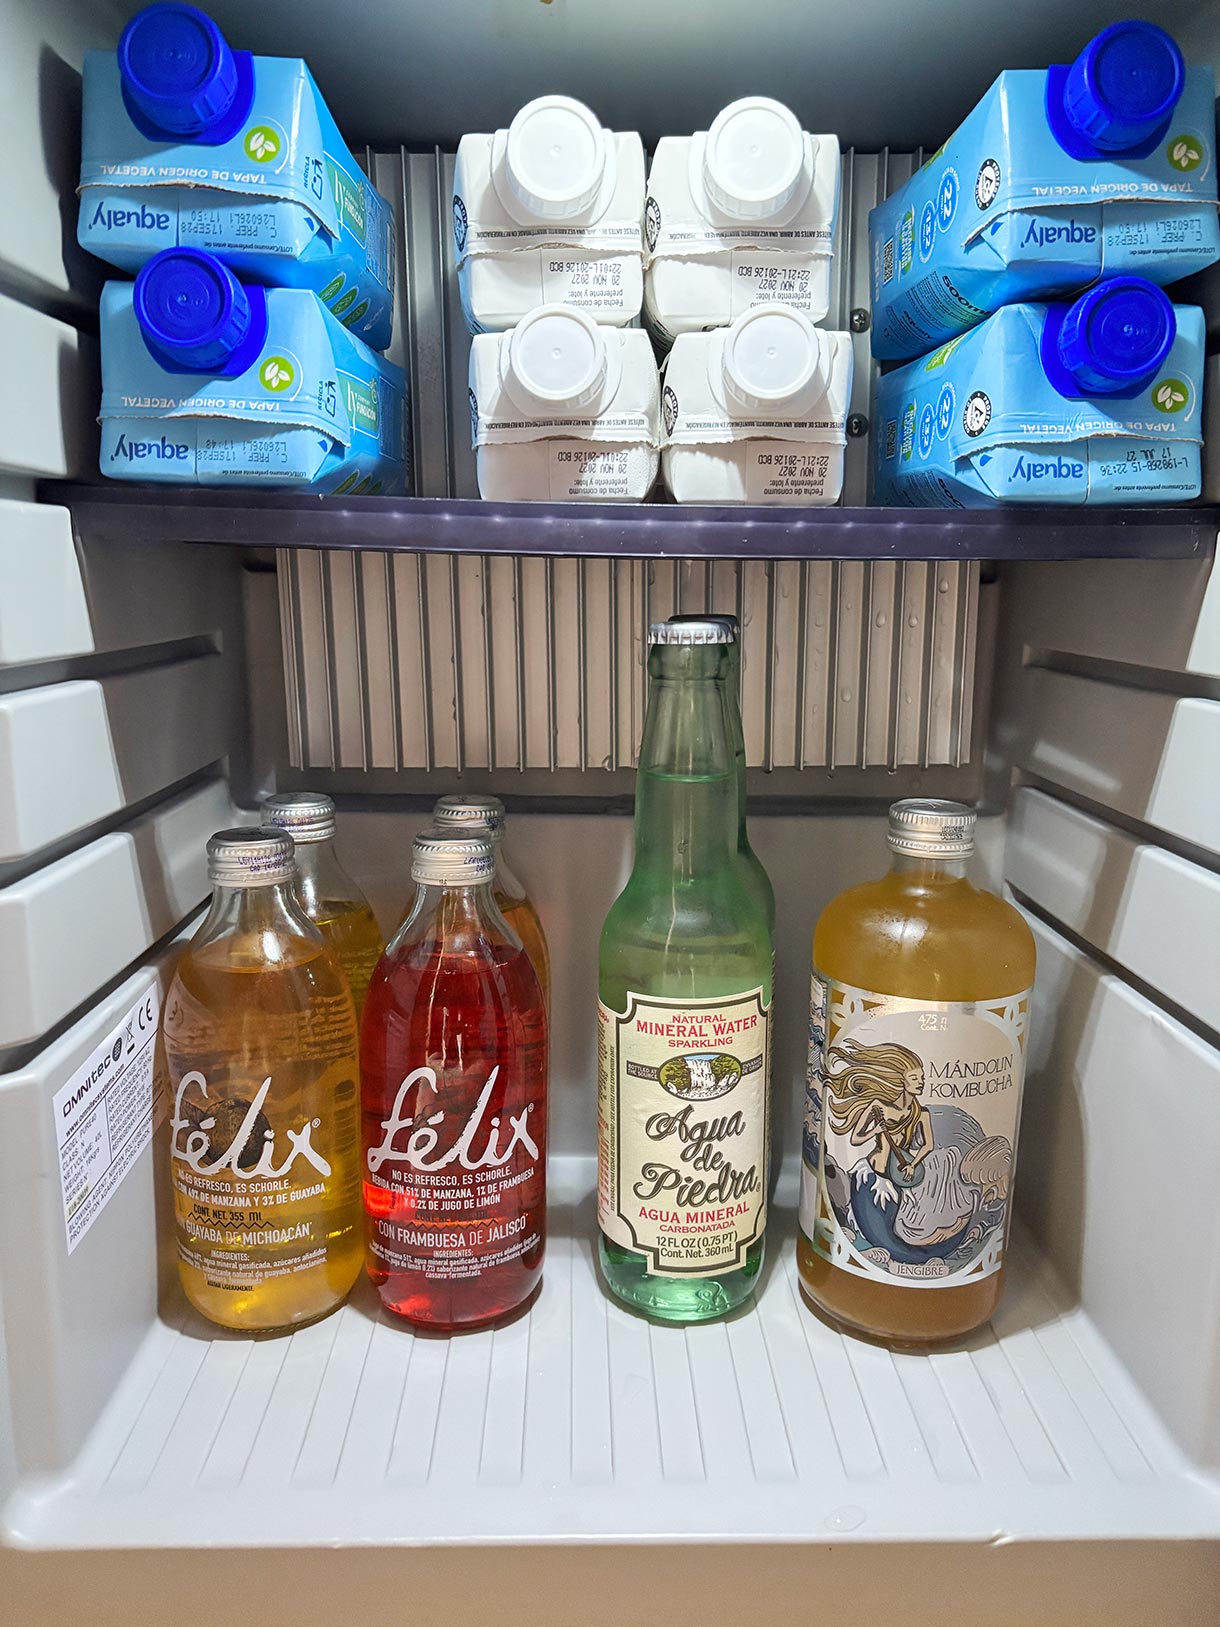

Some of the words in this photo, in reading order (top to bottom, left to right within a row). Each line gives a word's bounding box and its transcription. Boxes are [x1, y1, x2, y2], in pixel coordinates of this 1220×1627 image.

[100, 166, 156, 177] VEGETAL
[158, 167, 208, 178] ORIGEN
[212, 170, 229, 180] DE
[233, 172, 266, 184] TAPA
[1032, 185, 1091, 197] VEGETAL
[1092, 183, 1138, 194] ORIGEN
[1141, 183, 1158, 192] DE
[1161, 182, 1193, 193] TAPA
[572, 274, 590, 284] 2027
[594, 274, 607, 284] NOV
[612, 275, 620, 286] 20
[788, 270, 810, 281] 22:21
[759, 280, 777, 290] 2027
[781, 281, 794, 290] NOV
[800, 282, 808, 292] 20
[568, 290, 583, 298] lote:
[589, 289, 623, 298] preferente
[756, 292, 770, 300] lote:
[777, 291, 812, 301] preferente
[603, 299, 624, 307] Fecha
[120, 396, 176, 408] VEGETAL
[180, 399, 226, 410] ORIGEN
[228, 400, 247, 410] DE
[250, 402, 281, 412] TAPA
[1020, 424, 1072, 436] VEGETAL
[1076, 422, 1124, 432] ORIGEN
[1126, 422, 1142, 432] DE
[1145, 422, 1176, 433] TAPA
[1126, 451, 1136, 462] 27
[1140, 450, 1156, 460] JUL
[1161, 448, 1172, 458] 17
[807, 456, 830, 466] 22:21
[579, 462, 597, 473] 2027
[600, 464, 614, 474] NOV
[618, 463, 628, 474] 20
[779, 466, 798, 476] 2027
[800, 466, 814, 477] NOV
[818, 466, 828, 478] 20
[594, 479, 628, 487] preferente
[790, 480, 824, 488] preferente
[609, 488, 629, 496] Fecha
[764, 488, 793, 496] consumo
[794, 488, 803, 496] de
[804, 488, 824, 496] Fecha
[672, 1014, 727, 1024] NATURAL
[918, 1014, 938, 1024] 475
[636, 1019, 708, 1038] MINERAL
[712, 1014, 758, 1036] WATER
[668, 1036, 733, 1048] SPARKLING
[628, 1064, 650, 1074] BOTTLED
[929, 1054, 1014, 1078] MÁNDOLIN
[929, 1074, 1013, 1098] KOMBUCHA
[367, 1065, 539, 1172] félix
[170, 1071, 332, 1180] félix
[645, 1104, 746, 1162] Agua
[693, 1144, 726, 1172] de
[392, 1169, 402, 1181] NO
[404, 1172, 414, 1184] ES
[463, 1174, 473, 1185] ES
[476, 1166, 512, 1182] SCHORLE.
[186, 1174, 192, 1184] ES
[236, 1184, 246, 1194] ES
[250, 1179, 292, 1193] SCHORLE.
[372, 1173, 390, 1190] BEBIDA
[391, 1182, 404, 1194] CON
[406, 1186, 419, 1198] 51%
[421, 1188, 431, 1198] DE
[477, 1186, 486, 1196] 1%
[488, 1183, 498, 1194] DE
[499, 1168, 534, 1192] FRAMBUESA
[633, 1162, 758, 1208] Piedra
[201, 1192, 210, 1203] DE
[211, 1195, 252, 1208] MANZANA
[253, 1197, 260, 1207] Y
[262, 1195, 274, 1206] 3%
[276, 1193, 287, 1204] DE
[290, 1182, 326, 1202] GUAYABA
[410, 1199, 426, 1210] 0.2%
[428, 1200, 438, 1210] DE
[441, 1200, 462, 1210] JUGO
[464, 1198, 474, 1210] DE
[476, 1193, 500, 1208] LIMÓN
[194, 1204, 210, 1217] CONT.
[213, 1210, 228, 1220] NET.
[230, 1212, 244, 1221] 355
[639, 1206, 680, 1224] AGUA
[686, 1201, 750, 1224] MINERAL
[186, 1220, 223, 1244] GUAYABA
[226, 1231, 239, 1244] DE
[659, 1220, 736, 1234] CARBONATADA
[397, 1228, 466, 1248] FRAMBUESA
[470, 1230, 484, 1246] DE
[656, 1236, 668, 1246] 12
[668, 1238, 680, 1248] FL
[681, 1238, 696, 1248] OZ
[211, 1250, 250, 1262] INGREDIENTES:
[433, 1249, 474, 1258] INGREDIENTES:
[661, 1248, 684, 1258] Cont.
[686, 1247, 704, 1258] Net.
[705, 1248, 720, 1258] 360
[722, 1244, 734, 1254] mL
[428, 1257, 449, 1266] mineral
[896, 1265, 944, 1276] JENGIBRE
